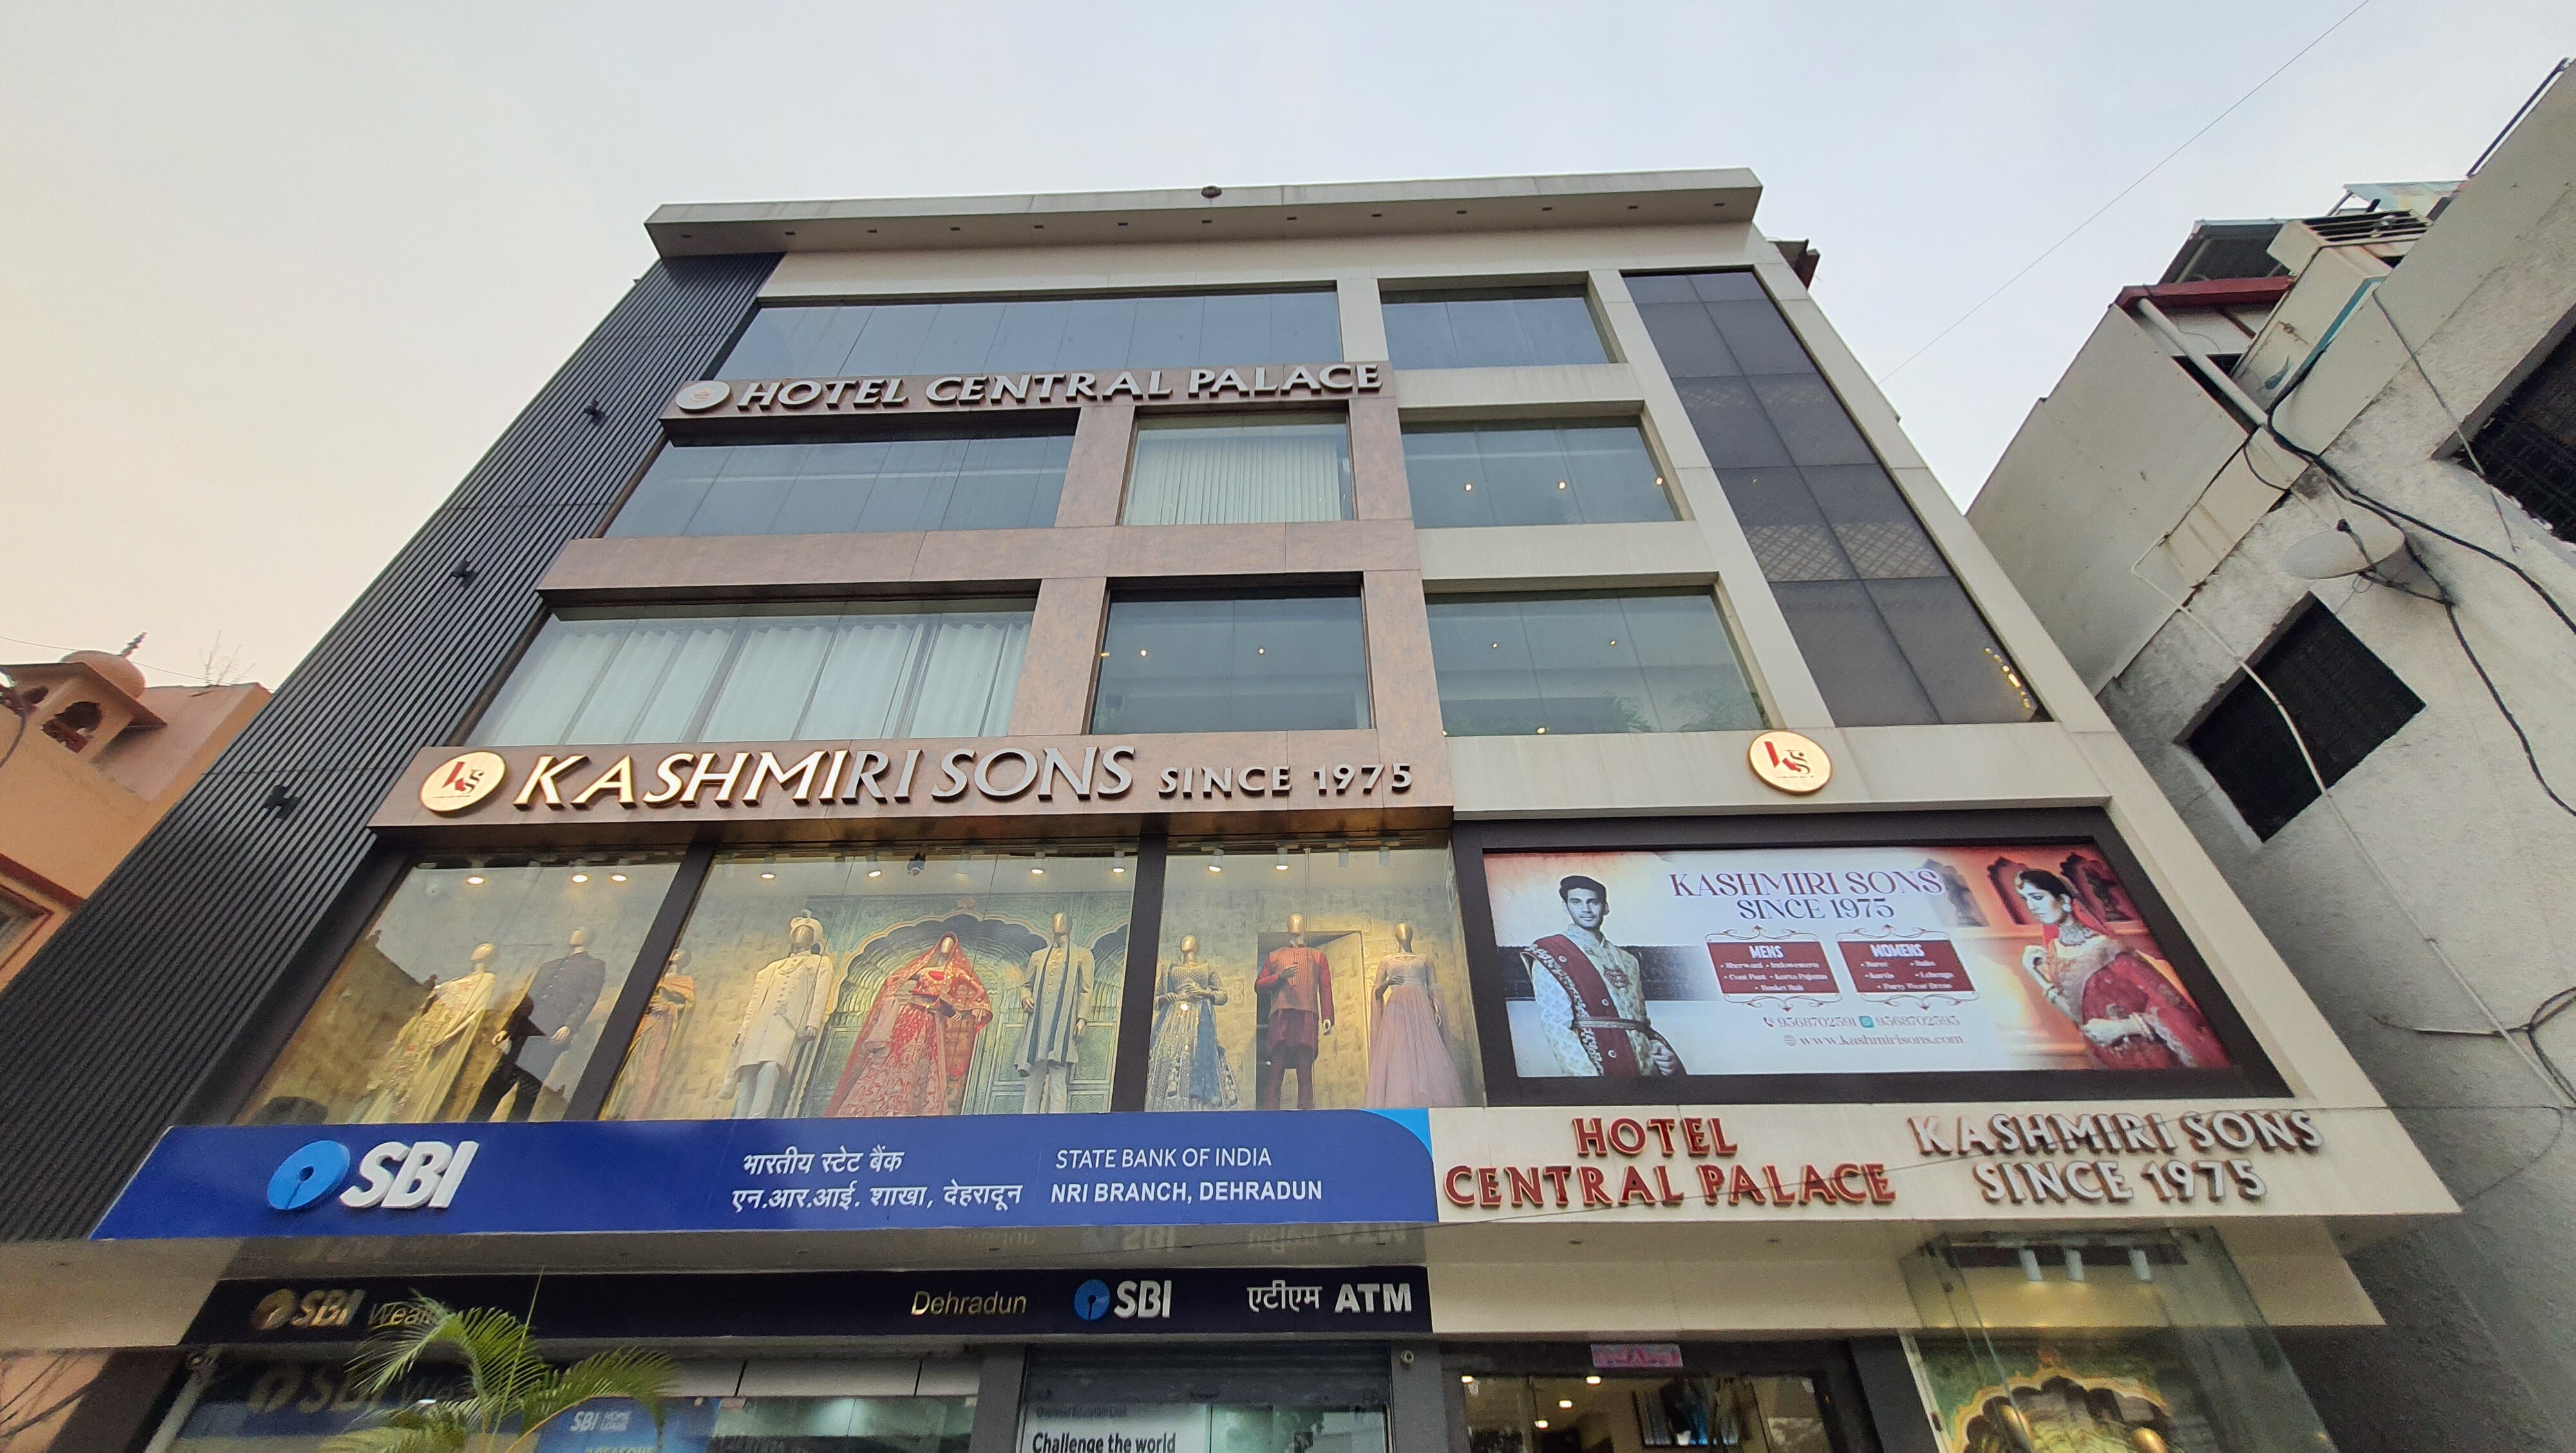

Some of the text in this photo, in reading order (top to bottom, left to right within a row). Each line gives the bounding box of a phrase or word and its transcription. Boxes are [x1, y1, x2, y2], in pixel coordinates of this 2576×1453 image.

[736, 364, 1383, 412] HOTEL CENTRAL PALACE
[513, 746, 1412, 810] KASHMIRI SONS SINCE 1975
[1669, 869, 1945, 897] KASHMIRI SONS
[1737, 897, 1894, 919] SINCE 1975
[1748, 945, 1784, 958] MENS
[1870, 944, 1926, 957] WOMENS
[1799, 1034, 1964, 1047] www.kashmirisons.com
[1572, 1117, 1738, 1157] HOTEL
[1908, 1110, 2322, 1156] KASHMIRI SONS
[743, 1144, 905, 1175] भारतीय स्टेट बैंक
[1056, 1147, 1273, 1169] STATE BANK OF INDIA
[339, 1140, 479, 1211] SBI
[1444, 1163, 1897, 1208] CENTRAL PALACE
[1973, 1160, 2267, 1203] SINCE 1975
[732, 1178, 1023, 1213] एन.आर.आई. शाखा, देहरादून
[1050, 1181, 1322, 1204] NRI BRANCH, DEHRADUN
[292, 1289, 366, 1327] SBI
[911, 1291, 1027, 1316] Dehradun
[1113, 1280, 1172, 1318] SBI
[1247, 1280, 1412, 1313] एटीएम ATM
[569, 1411, 599, 1432] SBI
[1032, 1432, 1176, 1453] Challenge the world
